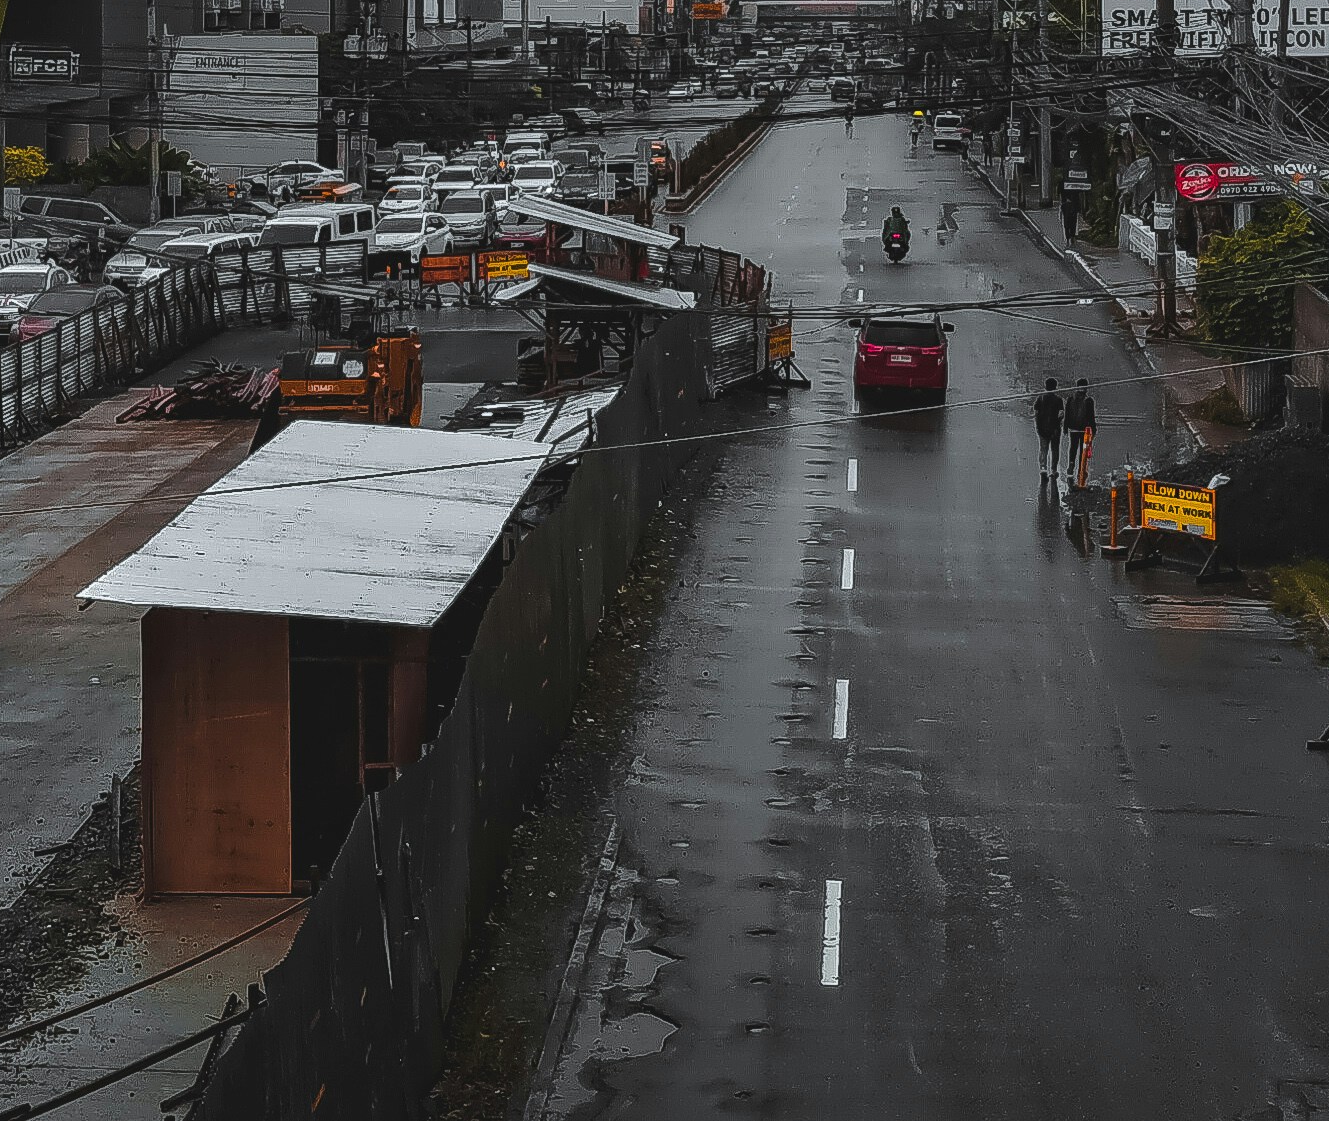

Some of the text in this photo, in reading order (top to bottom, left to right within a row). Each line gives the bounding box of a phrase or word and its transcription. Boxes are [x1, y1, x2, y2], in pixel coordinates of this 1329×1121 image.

[1147, 484, 1210, 502] SLOW DOWN
[1144, 501, 1212, 520] MEN AT WORK
